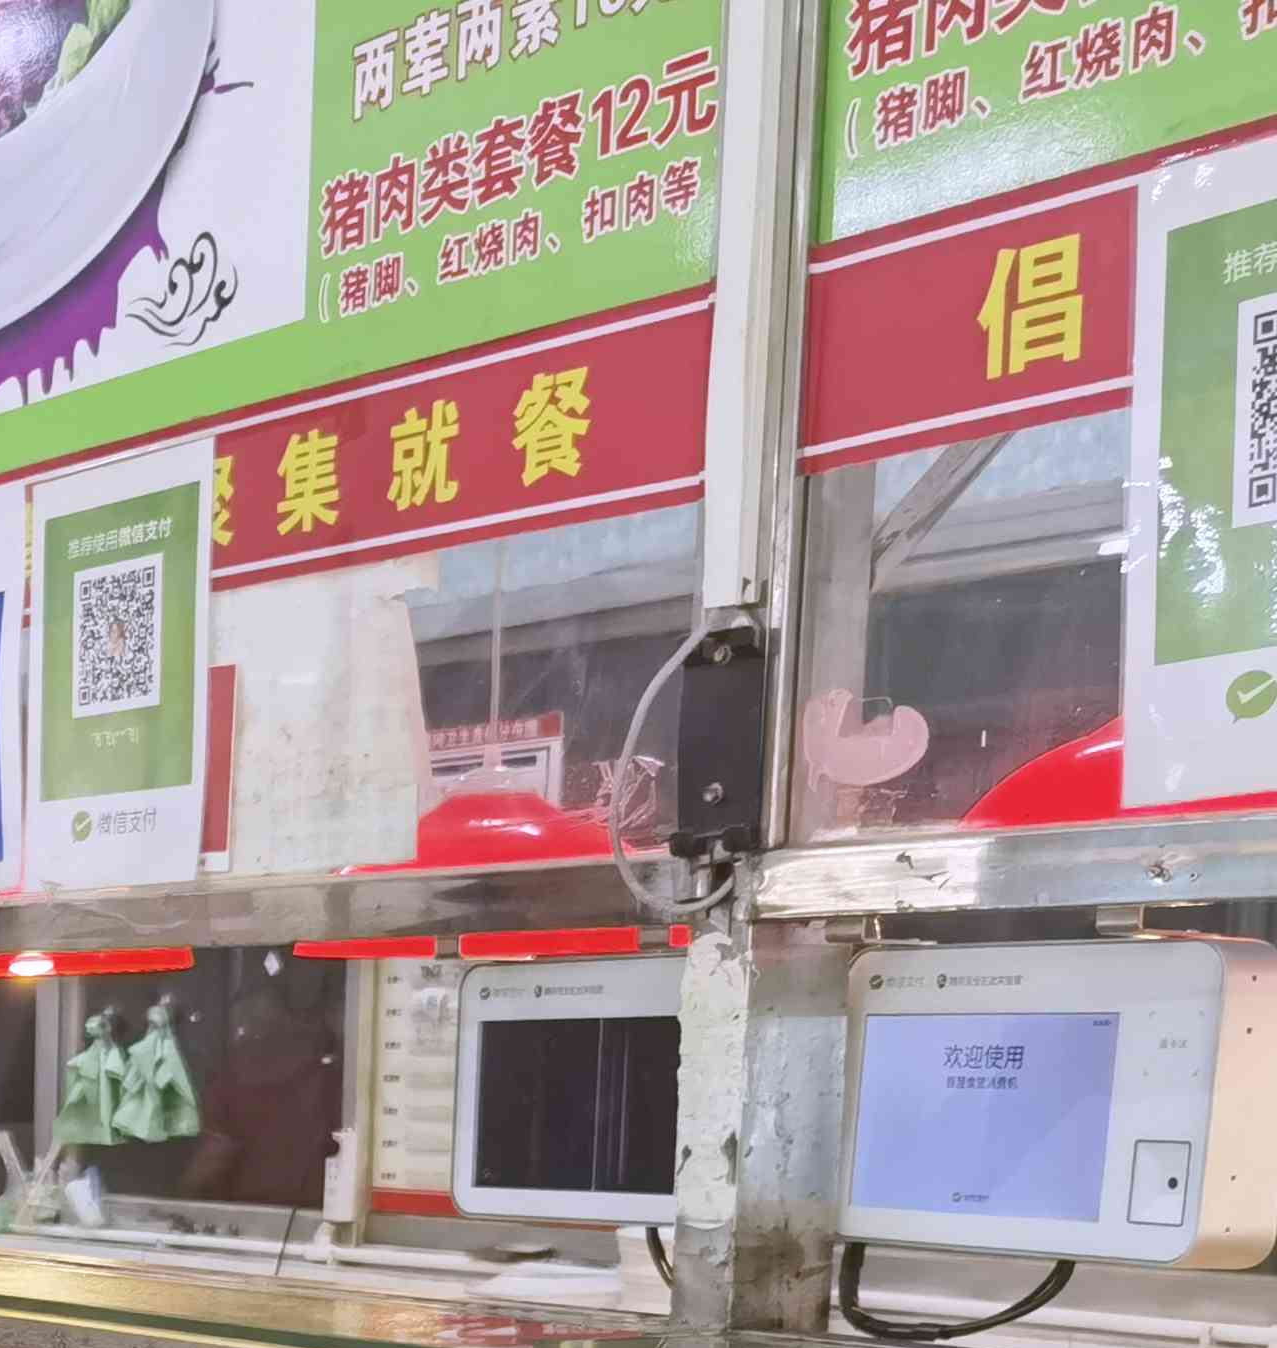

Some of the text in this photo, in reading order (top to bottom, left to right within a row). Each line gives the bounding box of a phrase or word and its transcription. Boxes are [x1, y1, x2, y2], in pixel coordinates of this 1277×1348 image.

[351, 0, 670, 121] 两荤两素
[319, 48, 719, 258] 猪肉类套餐12元
[976, 232, 1085, 381] 倡
[97, 807, 158, 836] 微信支付
[943, 1043, 1025, 1070] 欢迎使用
